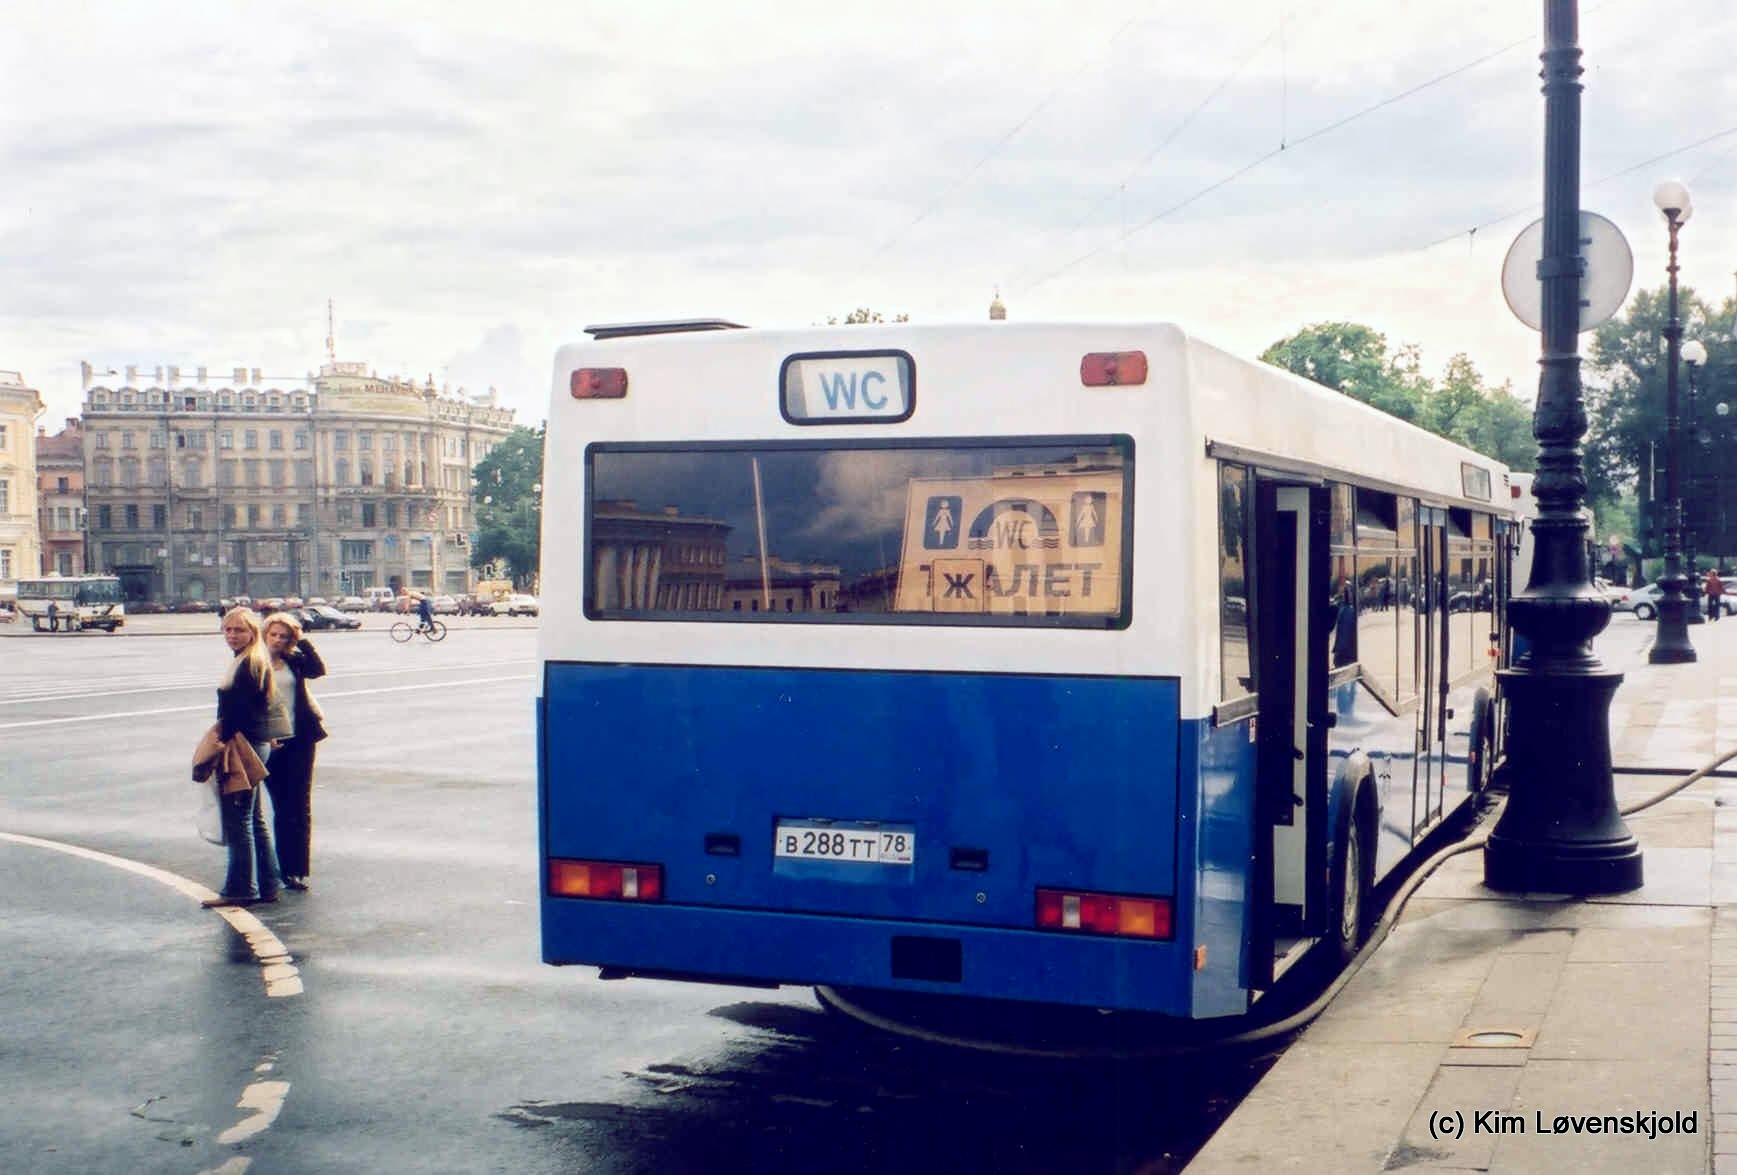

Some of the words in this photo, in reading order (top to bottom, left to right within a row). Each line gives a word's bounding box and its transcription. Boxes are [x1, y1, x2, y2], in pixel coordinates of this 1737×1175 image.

[818, 370, 888, 410] WC
[919, 562, 1103, 598] ТАЛЕТ
[943, 573, 975, 599] Ж
[883, 834, 906, 853] 78
